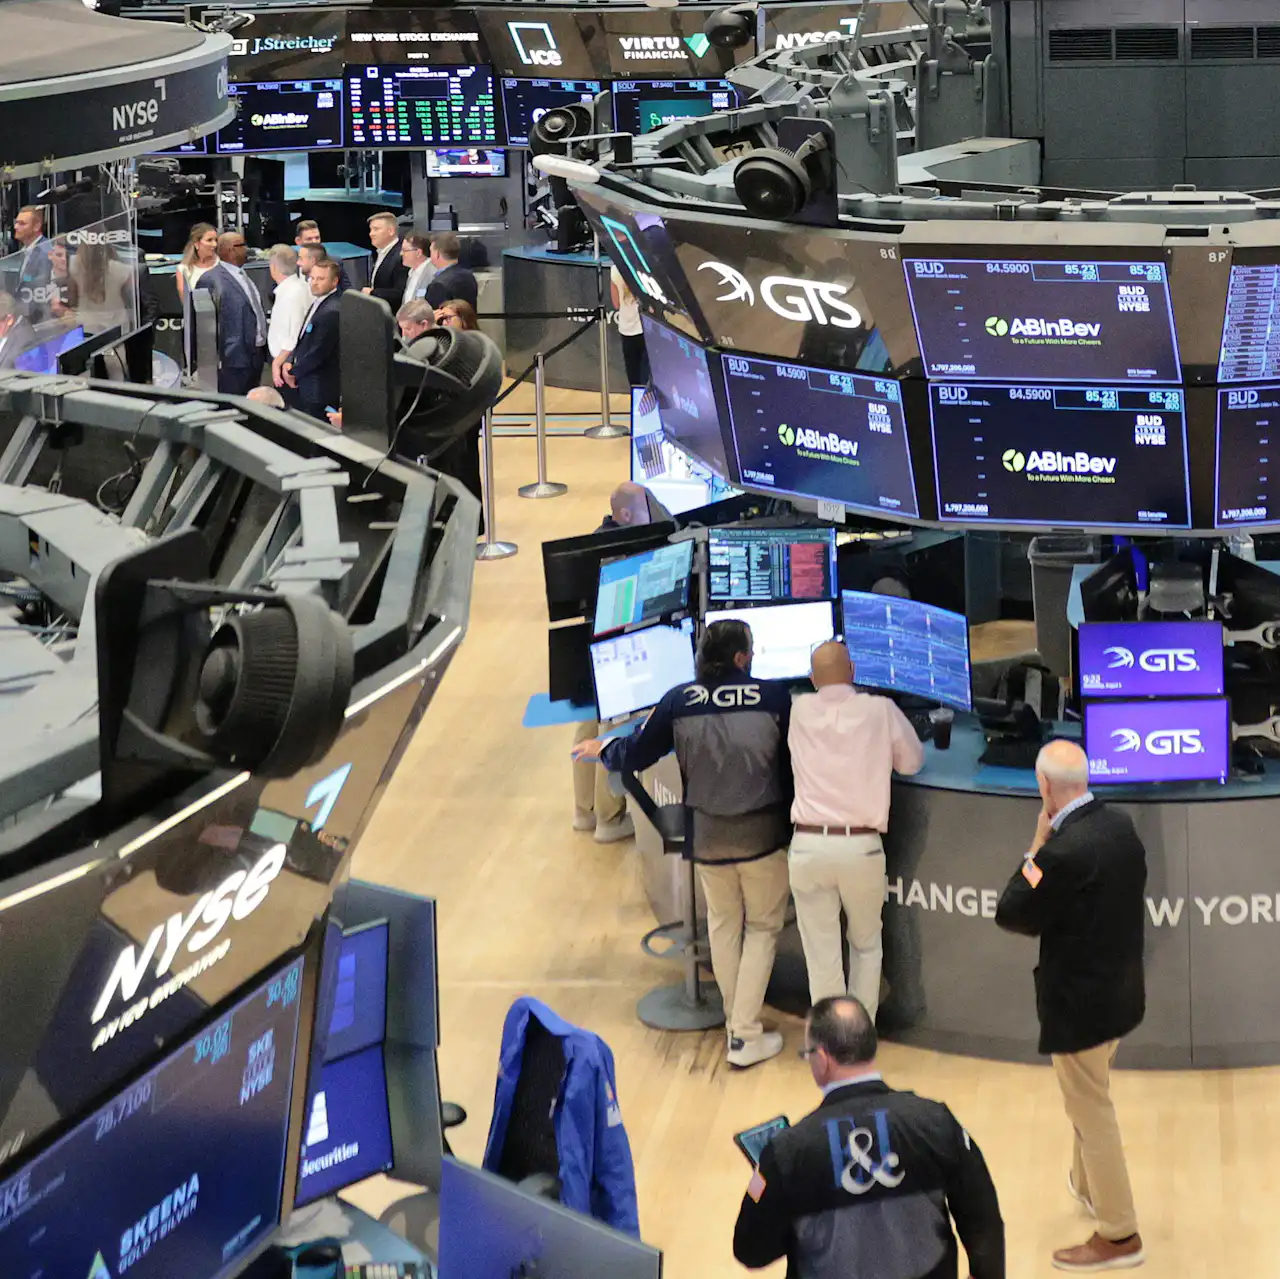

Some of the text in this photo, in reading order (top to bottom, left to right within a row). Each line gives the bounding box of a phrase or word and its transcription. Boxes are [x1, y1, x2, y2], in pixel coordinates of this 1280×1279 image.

[619, 36, 680, 50] VIRTU
[624, 51, 688, 60] FINANCIAL
[914, 262, 1161, 275] BUD 84.5900 85.23 85.28
[1118, 286, 1145, 295] BUD
[760, 275, 862, 329] GTS
[1118, 303, 1150, 312] NYSE
[1010, 318, 1101, 337] ABInBev
[728, 359, 749, 373] BUD
[939, 387, 1179, 403] BUD 84.5900 85.23 85.28
[1228, 390, 1258, 405] BUD
[1136, 415, 1163, 425] BUD
[795, 427, 859, 456] ABInBev
[1135, 434, 1167, 445] NYSE
[1026, 451, 1117, 473] ABInBev
[1139, 648, 1199, 672] GTS
[712, 684, 761, 708] GTS
[1145, 728, 1204, 755] GTS
[884, 876, 998, 919] HANGE
